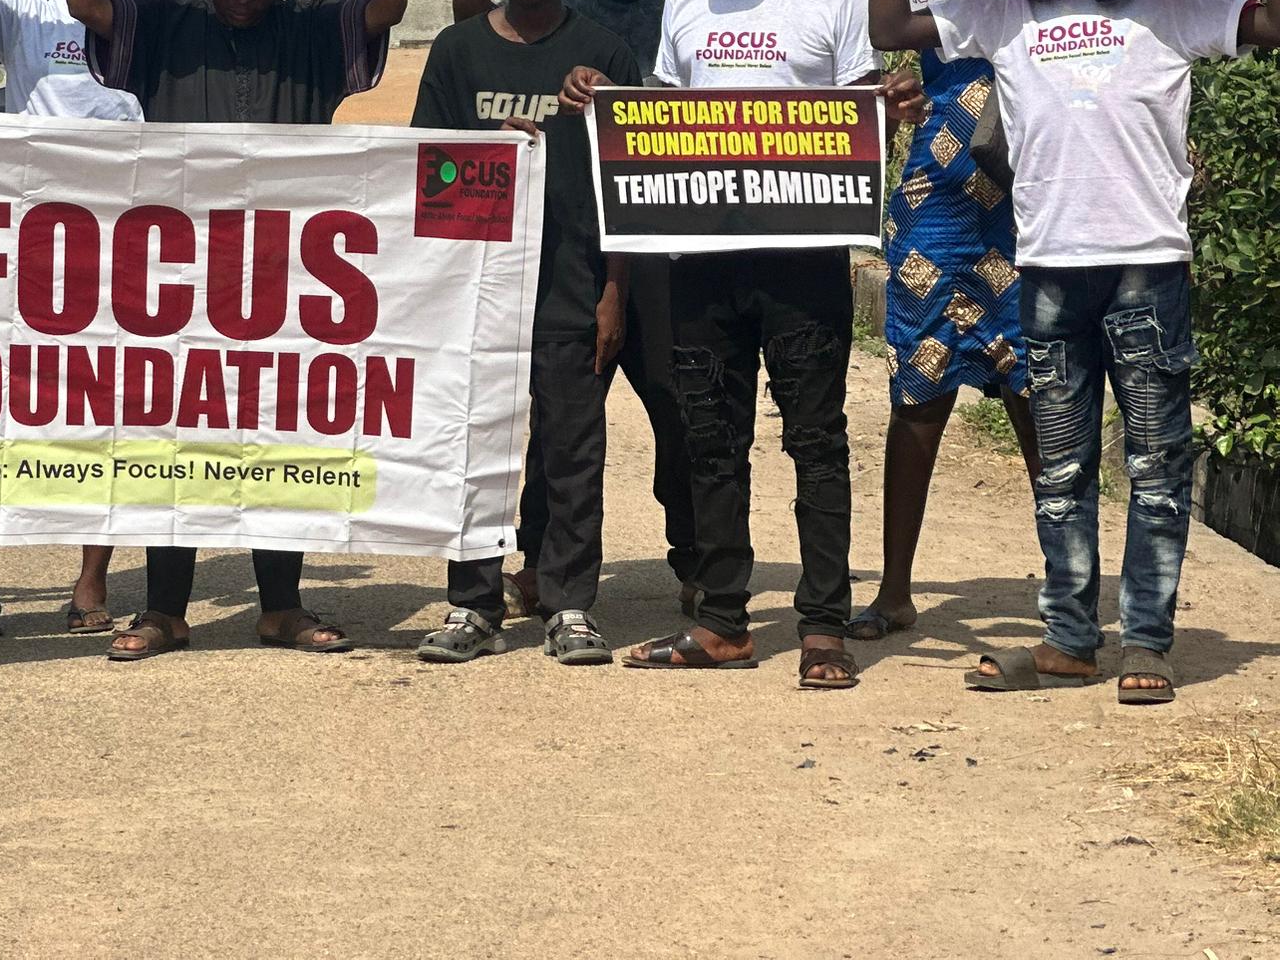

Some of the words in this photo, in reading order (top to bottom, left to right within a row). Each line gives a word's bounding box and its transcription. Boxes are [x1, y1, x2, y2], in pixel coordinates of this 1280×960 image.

[706, 31, 777, 48] FOCUS
[1038, 19, 1112, 42] FOCUS
[695, 48, 787, 62] FOUNDATION
[1029, 35, 1125, 56] FOUNDATION
[612, 100, 736, 125] SANCTUARY
[743, 101, 782, 124] FOR
[788, 101, 858, 125] FOCUS
[626, 131, 757, 156] FOUNDATION
[762, 131, 851, 156] PIONEER
[614, 169, 740, 205] TEMITOPE
[742, 169, 873, 205] BAMIDELE
[16, 459, 104, 481] Always
[113, 460, 195, 480] Focus!
[204, 462, 276, 482] Never
[282, 464, 361, 488] Relent
